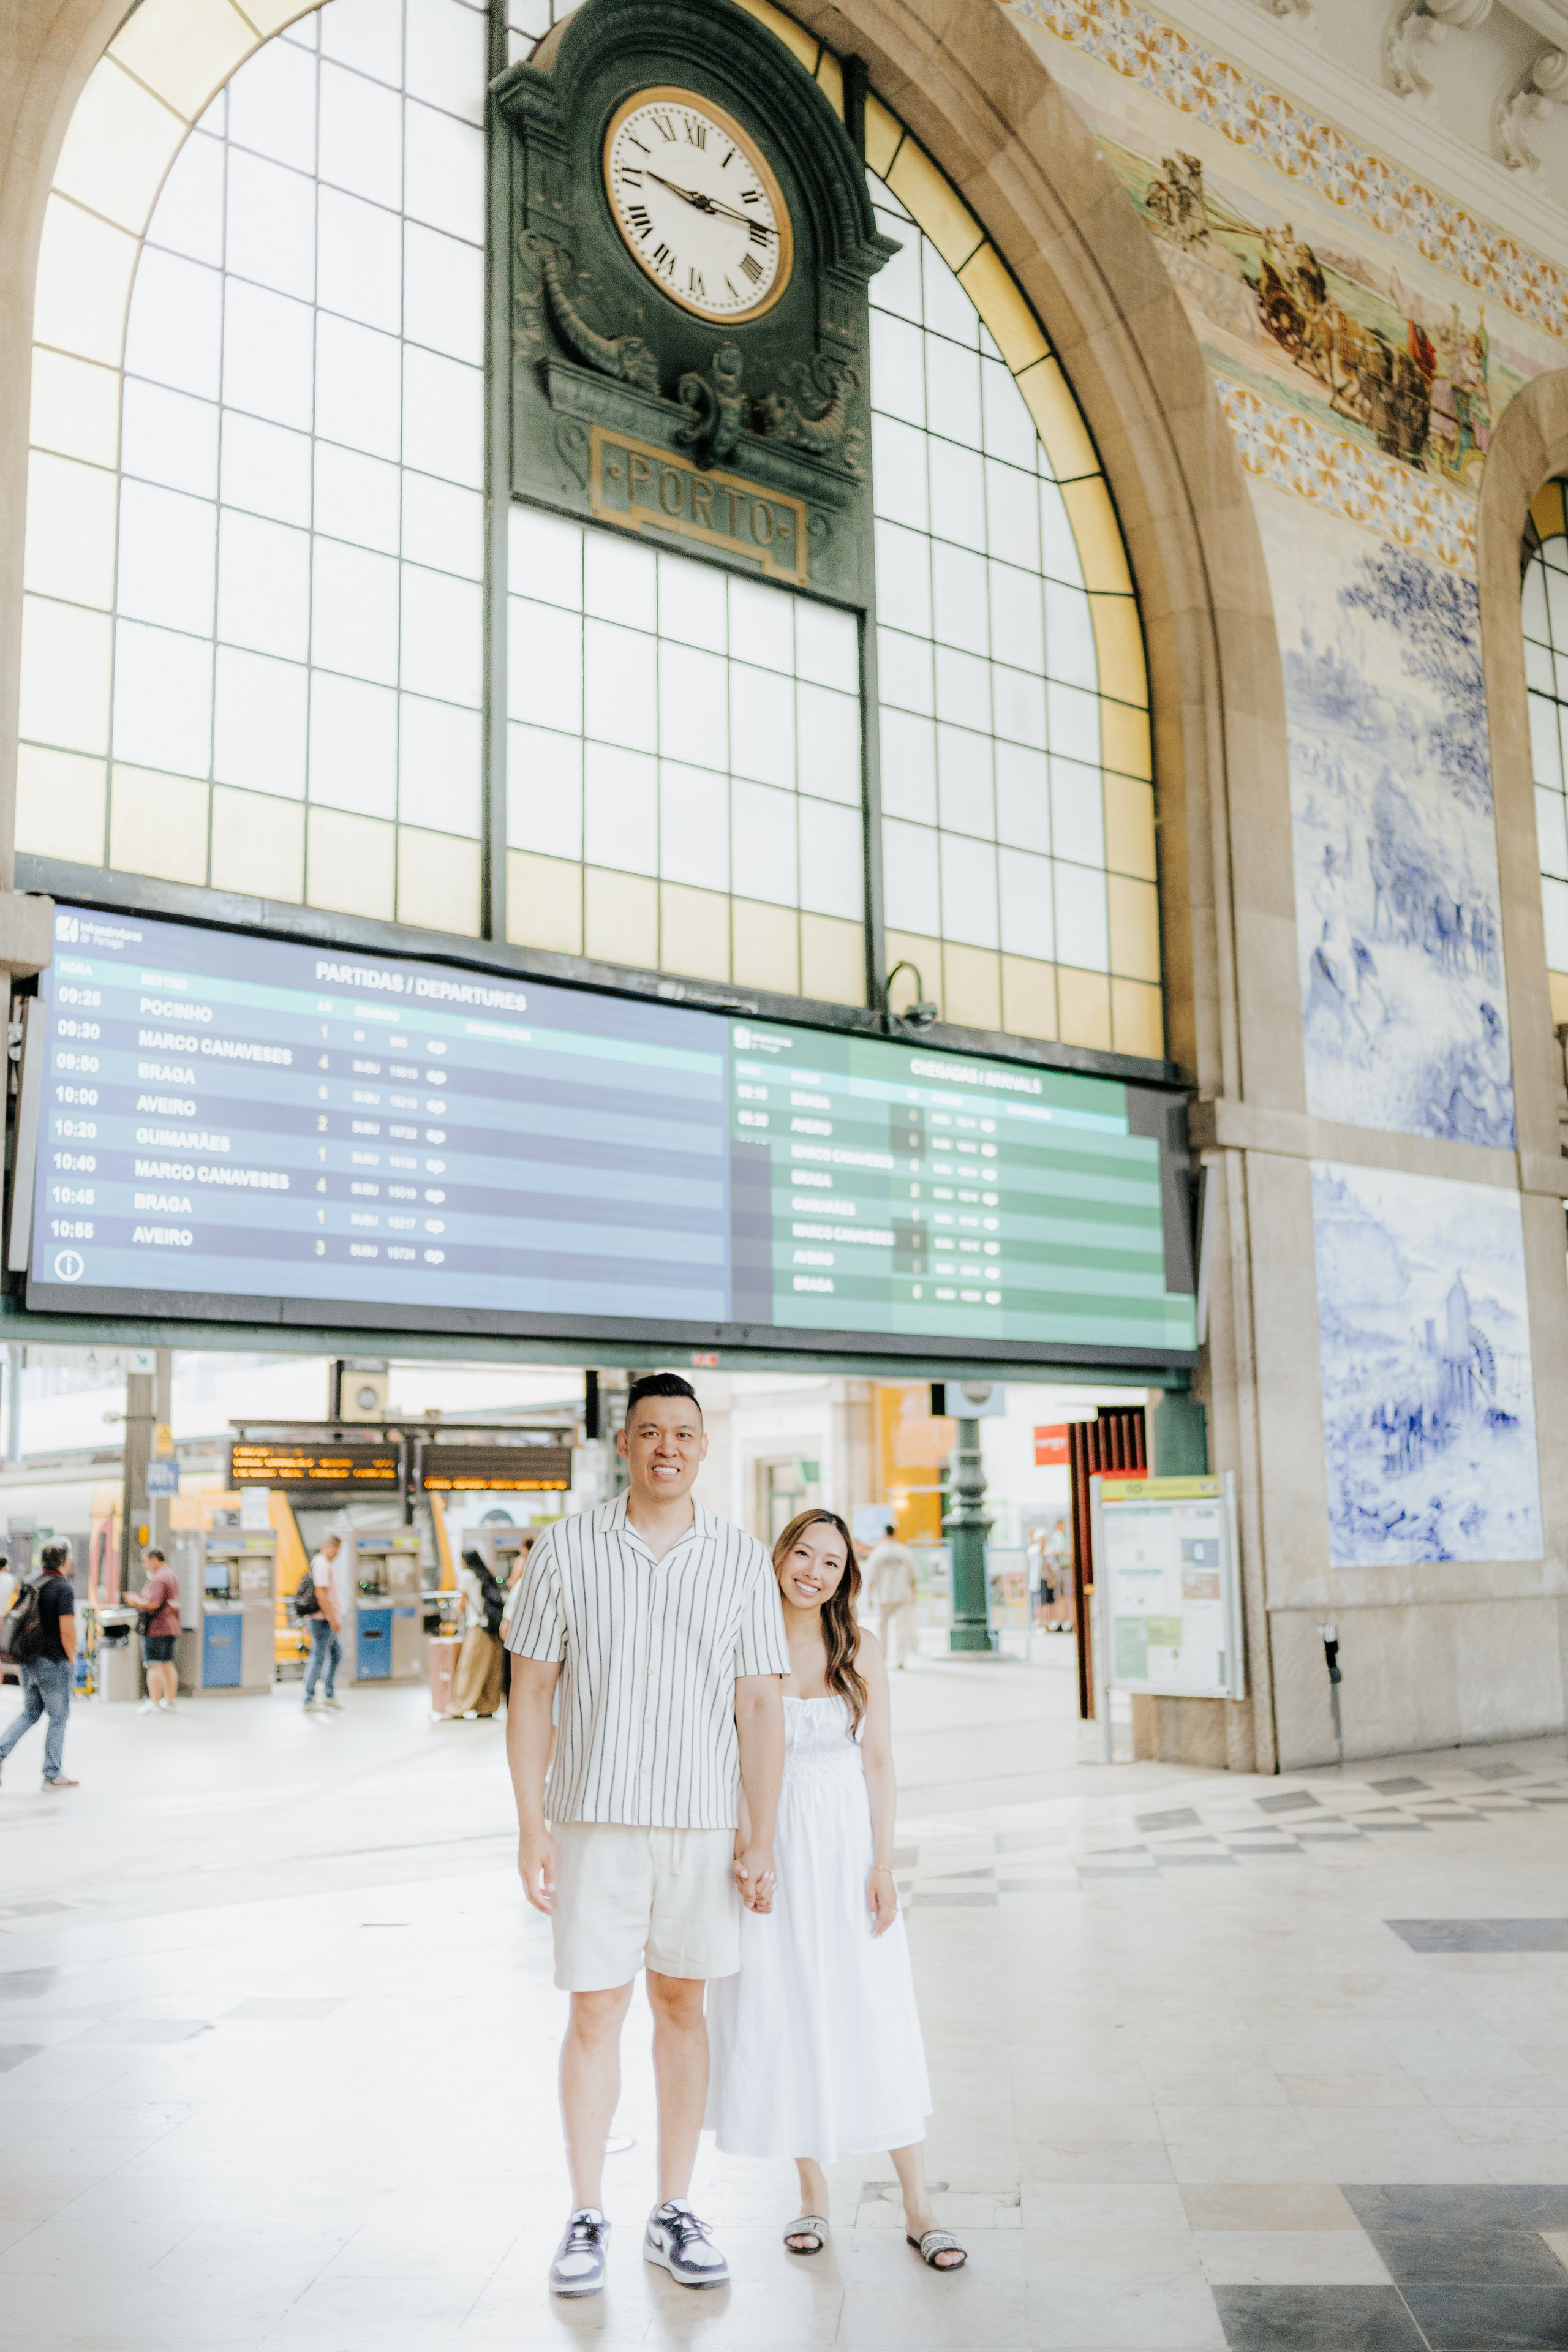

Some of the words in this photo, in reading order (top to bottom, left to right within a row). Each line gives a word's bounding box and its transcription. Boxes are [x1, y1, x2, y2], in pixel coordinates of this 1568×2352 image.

[627, 453, 774, 546] PORTO
[59, 960, 93, 977] HORA
[316, 962, 404, 992] PARTIDAS
[406, 977, 414, 993] /
[416, 978, 527, 1011] DEPARTURES
[59, 986, 102, 1007] 09:25
[140, 998, 213, 1022] POCINHO
[58, 1019, 100, 1039] 09:30
[139, 1030, 198, 1052] MARCO
[201, 1038, 292, 1065] CANAVESES
[56, 1052, 100, 1072] 09:50
[138, 1062, 196, 1085] BRAGA
[910, 1058, 978, 1084] CHEGADAS
[986, 1070, 1043, 1095] ARRIVALS
[56, 1085, 99, 1106] 10:00
[137, 1095, 196, 1117] AVEIRO
[55, 1120, 97, 1139] 10:20
[135, 1127, 230, 1152] GUIMARÃES
[54, 1153, 96, 1172] 10:40
[135, 1160, 195, 1181] MARCO
[197, 1166, 289, 1189] CANAVESES
[53, 1186, 95, 1205] 10:45
[134, 1193, 192, 1213] BRAGA
[132, 1226, 193, 1246] AVEIRO
